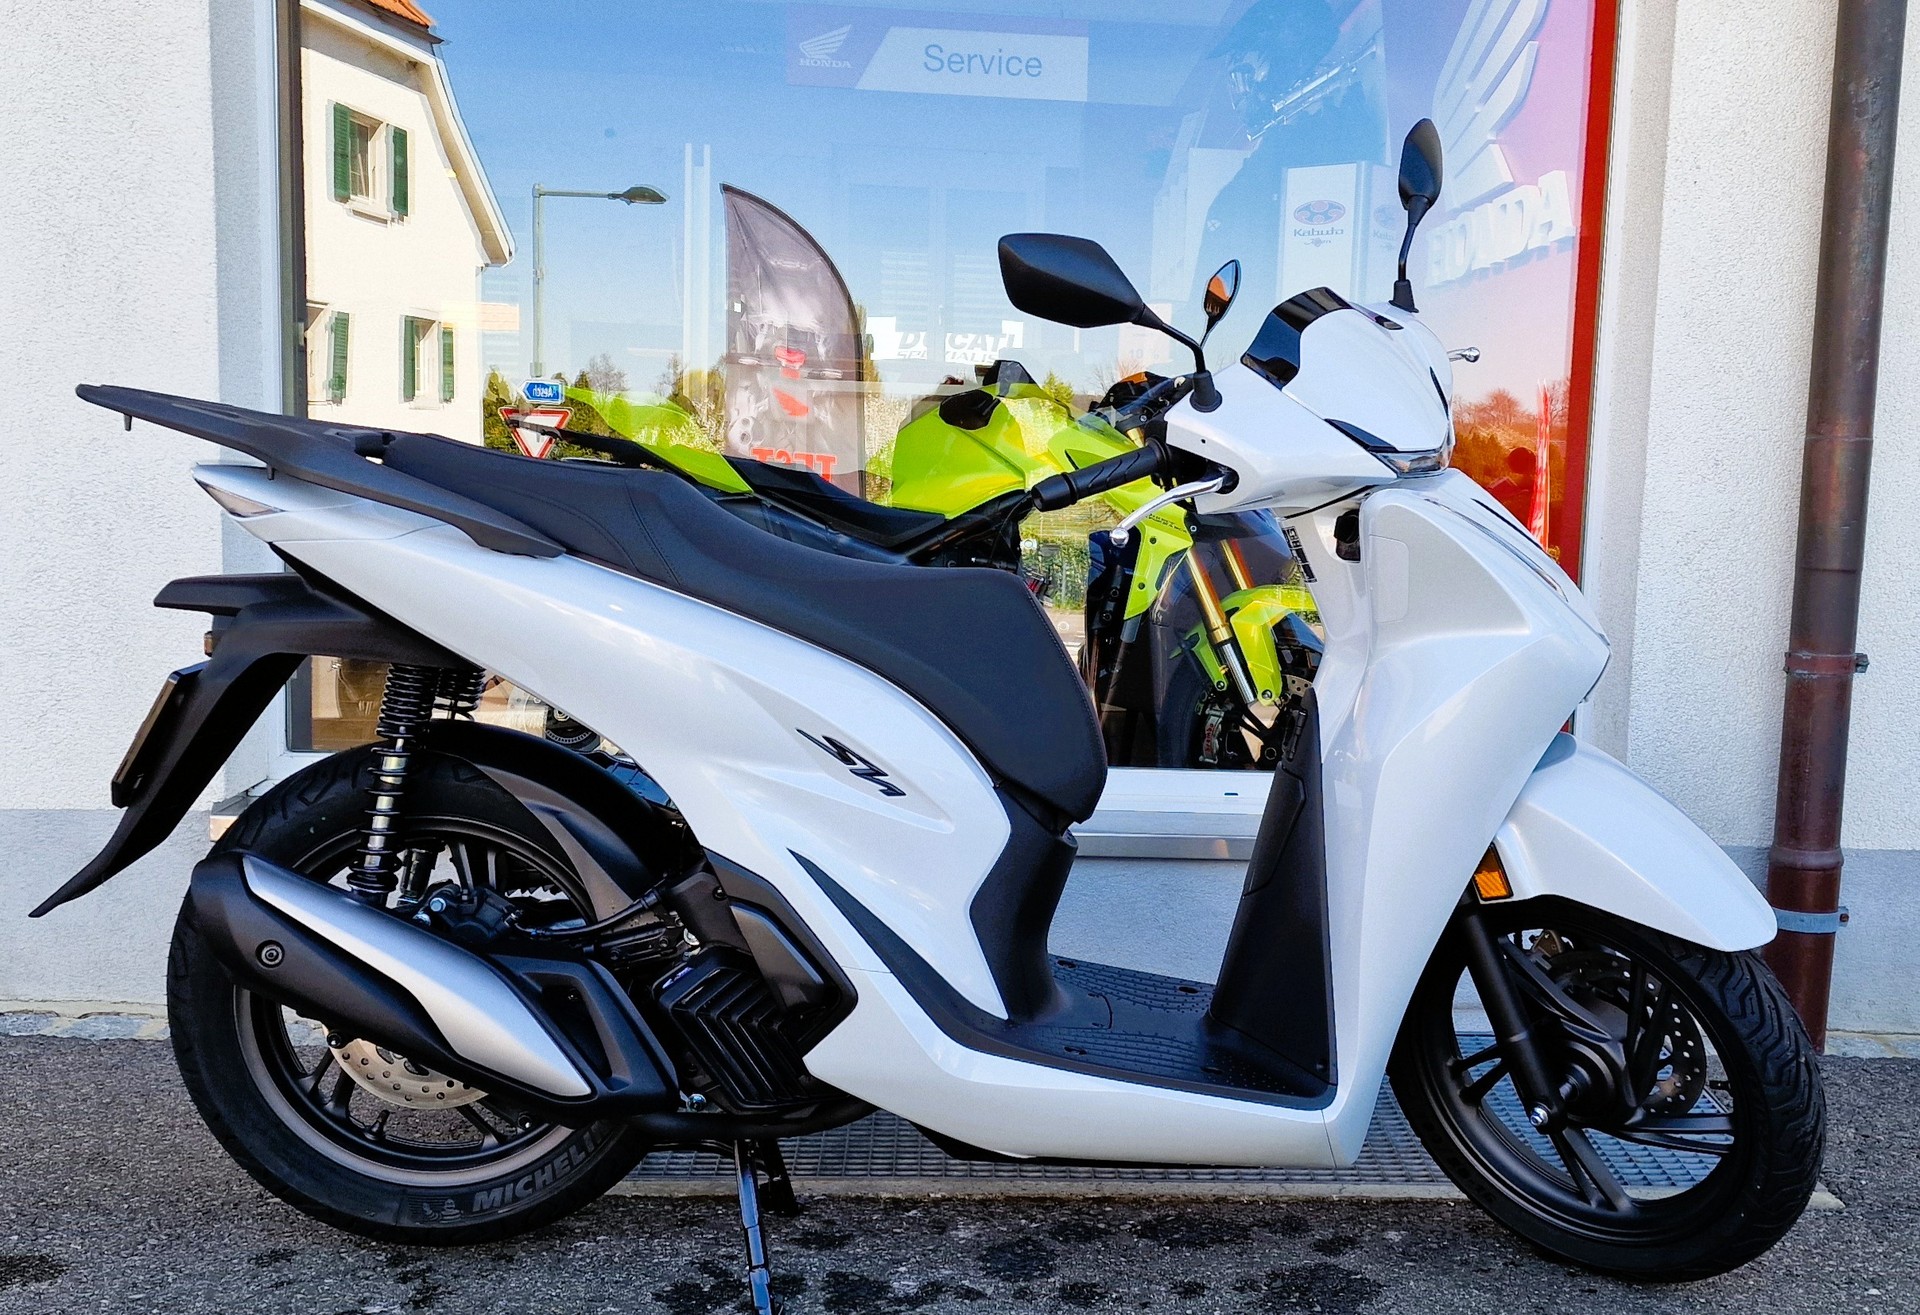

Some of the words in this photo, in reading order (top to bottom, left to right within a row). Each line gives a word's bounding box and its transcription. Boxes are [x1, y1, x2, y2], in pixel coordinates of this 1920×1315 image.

[798, 58, 854, 69] HONDA
[923, 44, 1043, 78] Service
[1293, 226, 1345, 238] Kabuto
[897, 331, 1017, 352] DCATI
